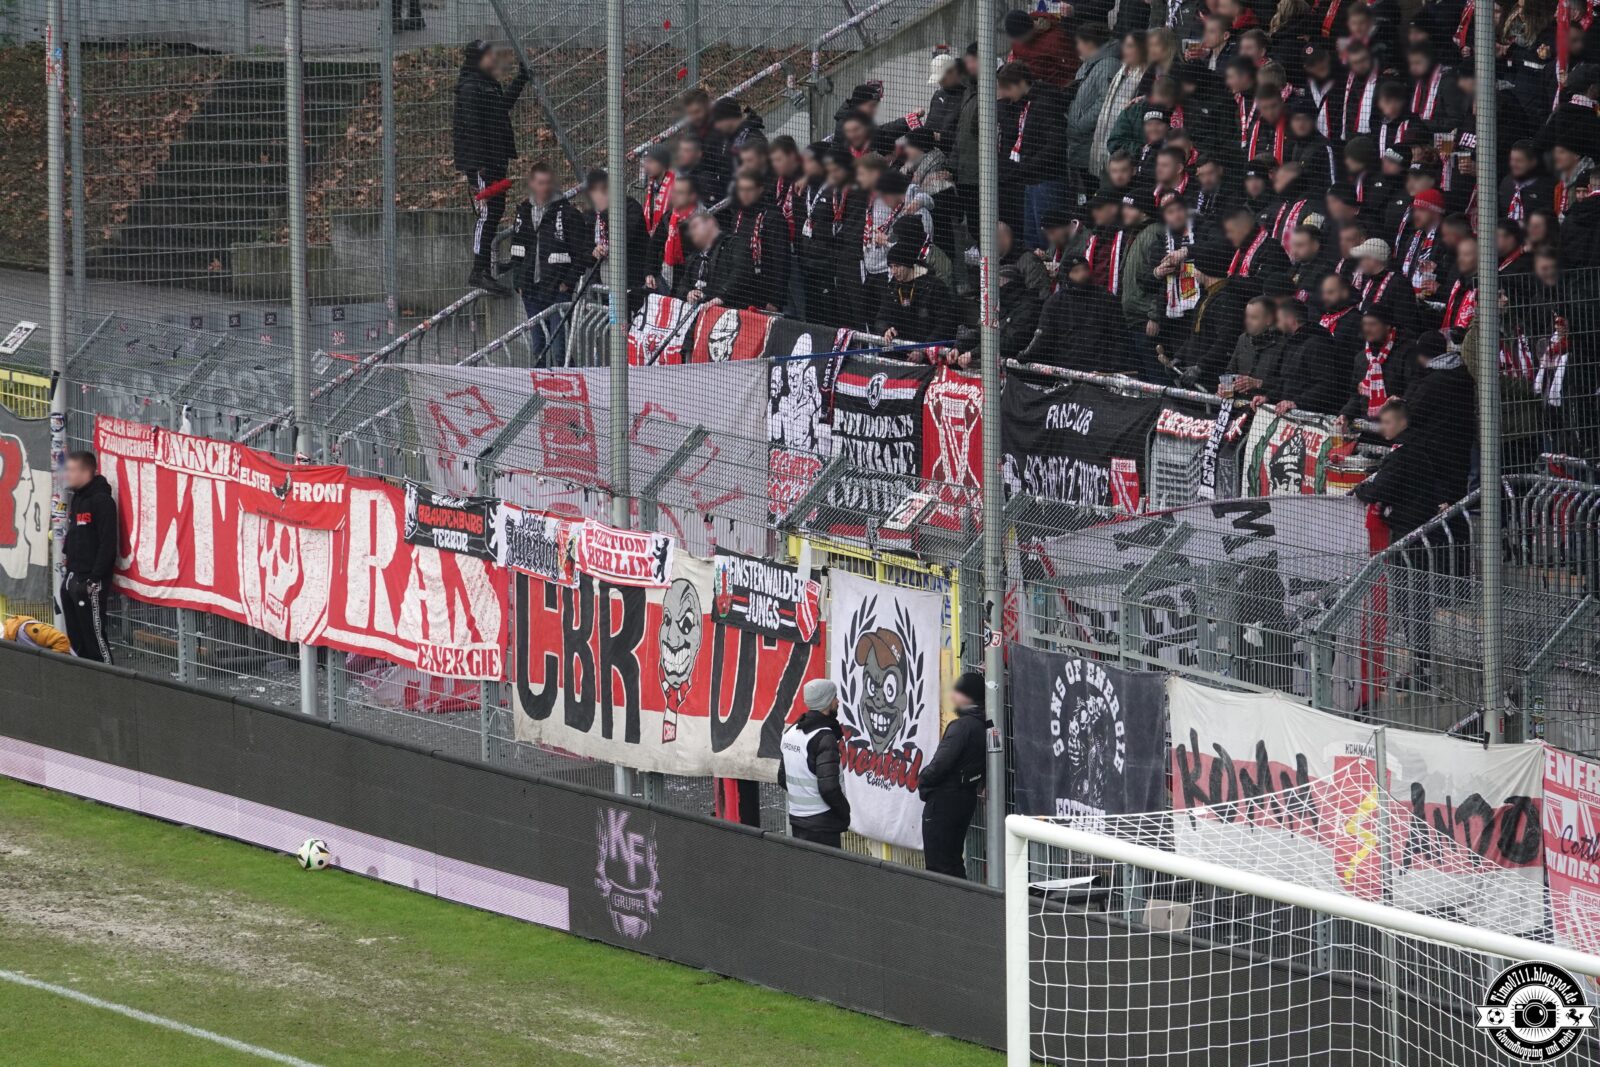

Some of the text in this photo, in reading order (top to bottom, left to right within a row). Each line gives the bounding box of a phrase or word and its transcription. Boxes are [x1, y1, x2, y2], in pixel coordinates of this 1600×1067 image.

[1046, 402, 1094, 435] FANCLUB
[240, 466, 345, 504] ELSTER FRONT
[418, 504, 483, 535] BRANDENBURG
[432, 527, 469, 553] TERROR
[593, 527, 647, 554] SEKTION
[587, 545, 655, 578] BERLIN
[728, 555, 806, 606] FINSTERWALDER
[745, 592, 780, 631] JUNGS
[417, 644, 501, 678] ENERGIE
[516, 571, 647, 745] CBR
[1051, 659, 1126, 775] SONS OF ENERGIE
